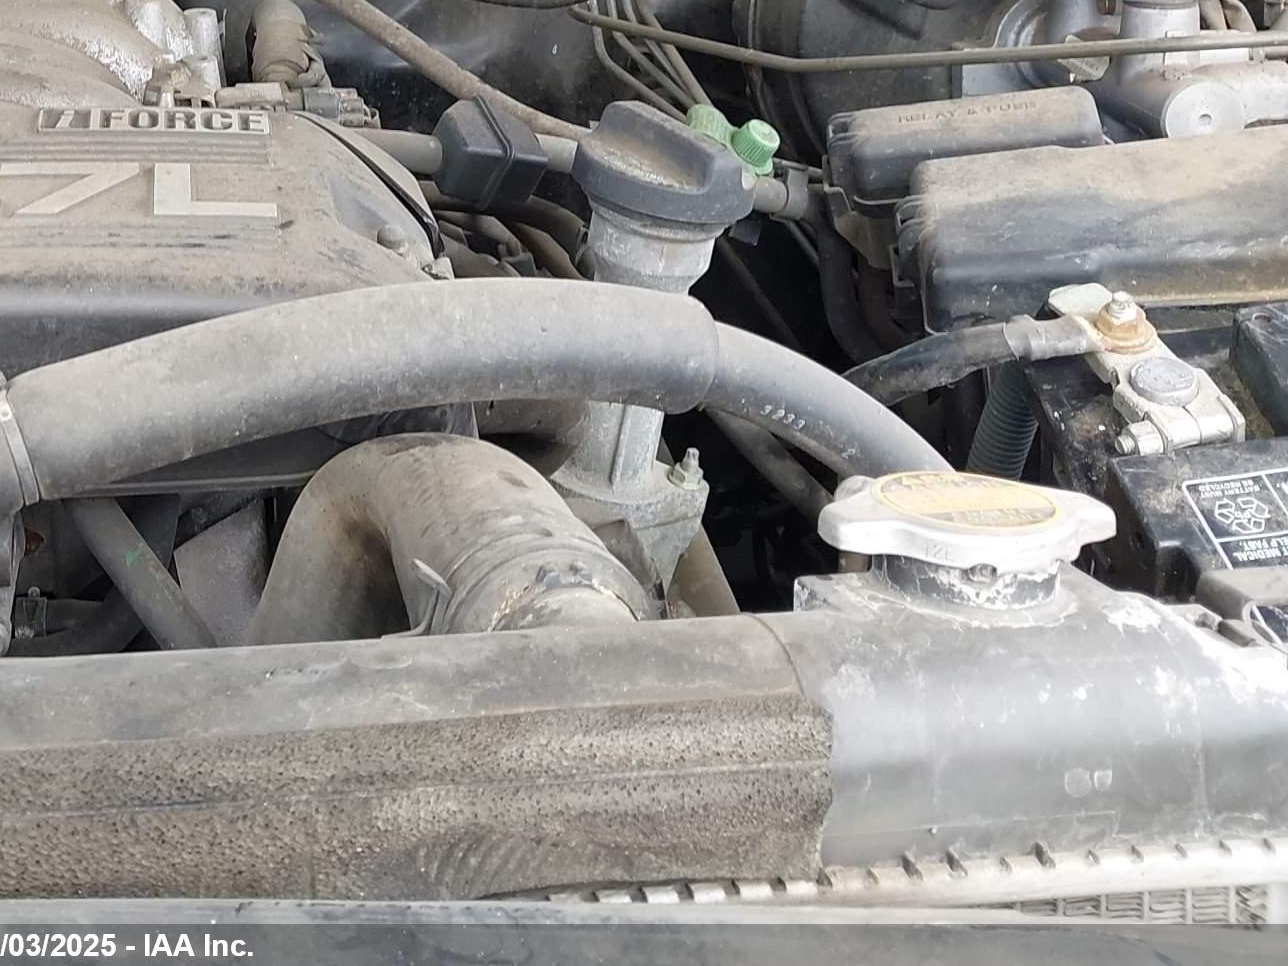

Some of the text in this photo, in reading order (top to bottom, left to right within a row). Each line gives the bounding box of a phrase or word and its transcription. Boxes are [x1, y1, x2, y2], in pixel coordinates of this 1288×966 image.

[101, 109, 265, 132] FORCE
[1239, 538, 1269, 551] FAST.
[1233, 548, 1282, 561] MEDICAL
